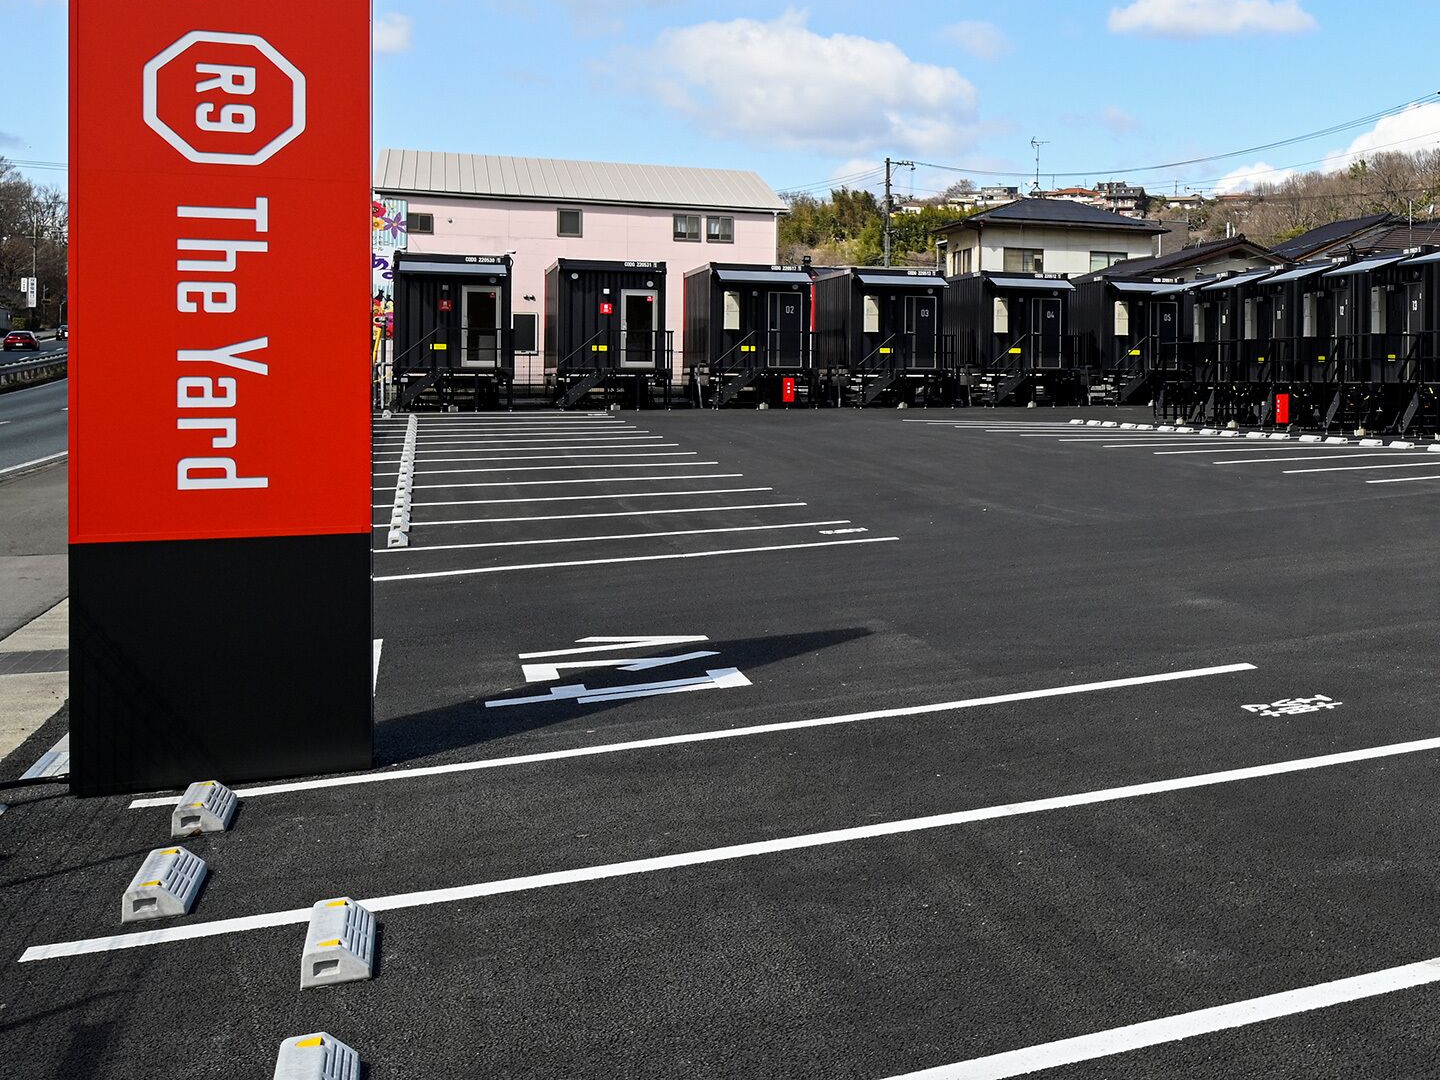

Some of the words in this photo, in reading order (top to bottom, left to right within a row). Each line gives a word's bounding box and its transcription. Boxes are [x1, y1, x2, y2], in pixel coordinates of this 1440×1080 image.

[196, 63, 256, 133] R9
[177, 196, 268, 314] The
[785, 305, 795, 314] 02
[920, 309, 930, 317] 03
[1046, 310, 1055, 319] 04
[1163, 313, 1172, 322] 05
[177, 336, 268, 490] Yard
